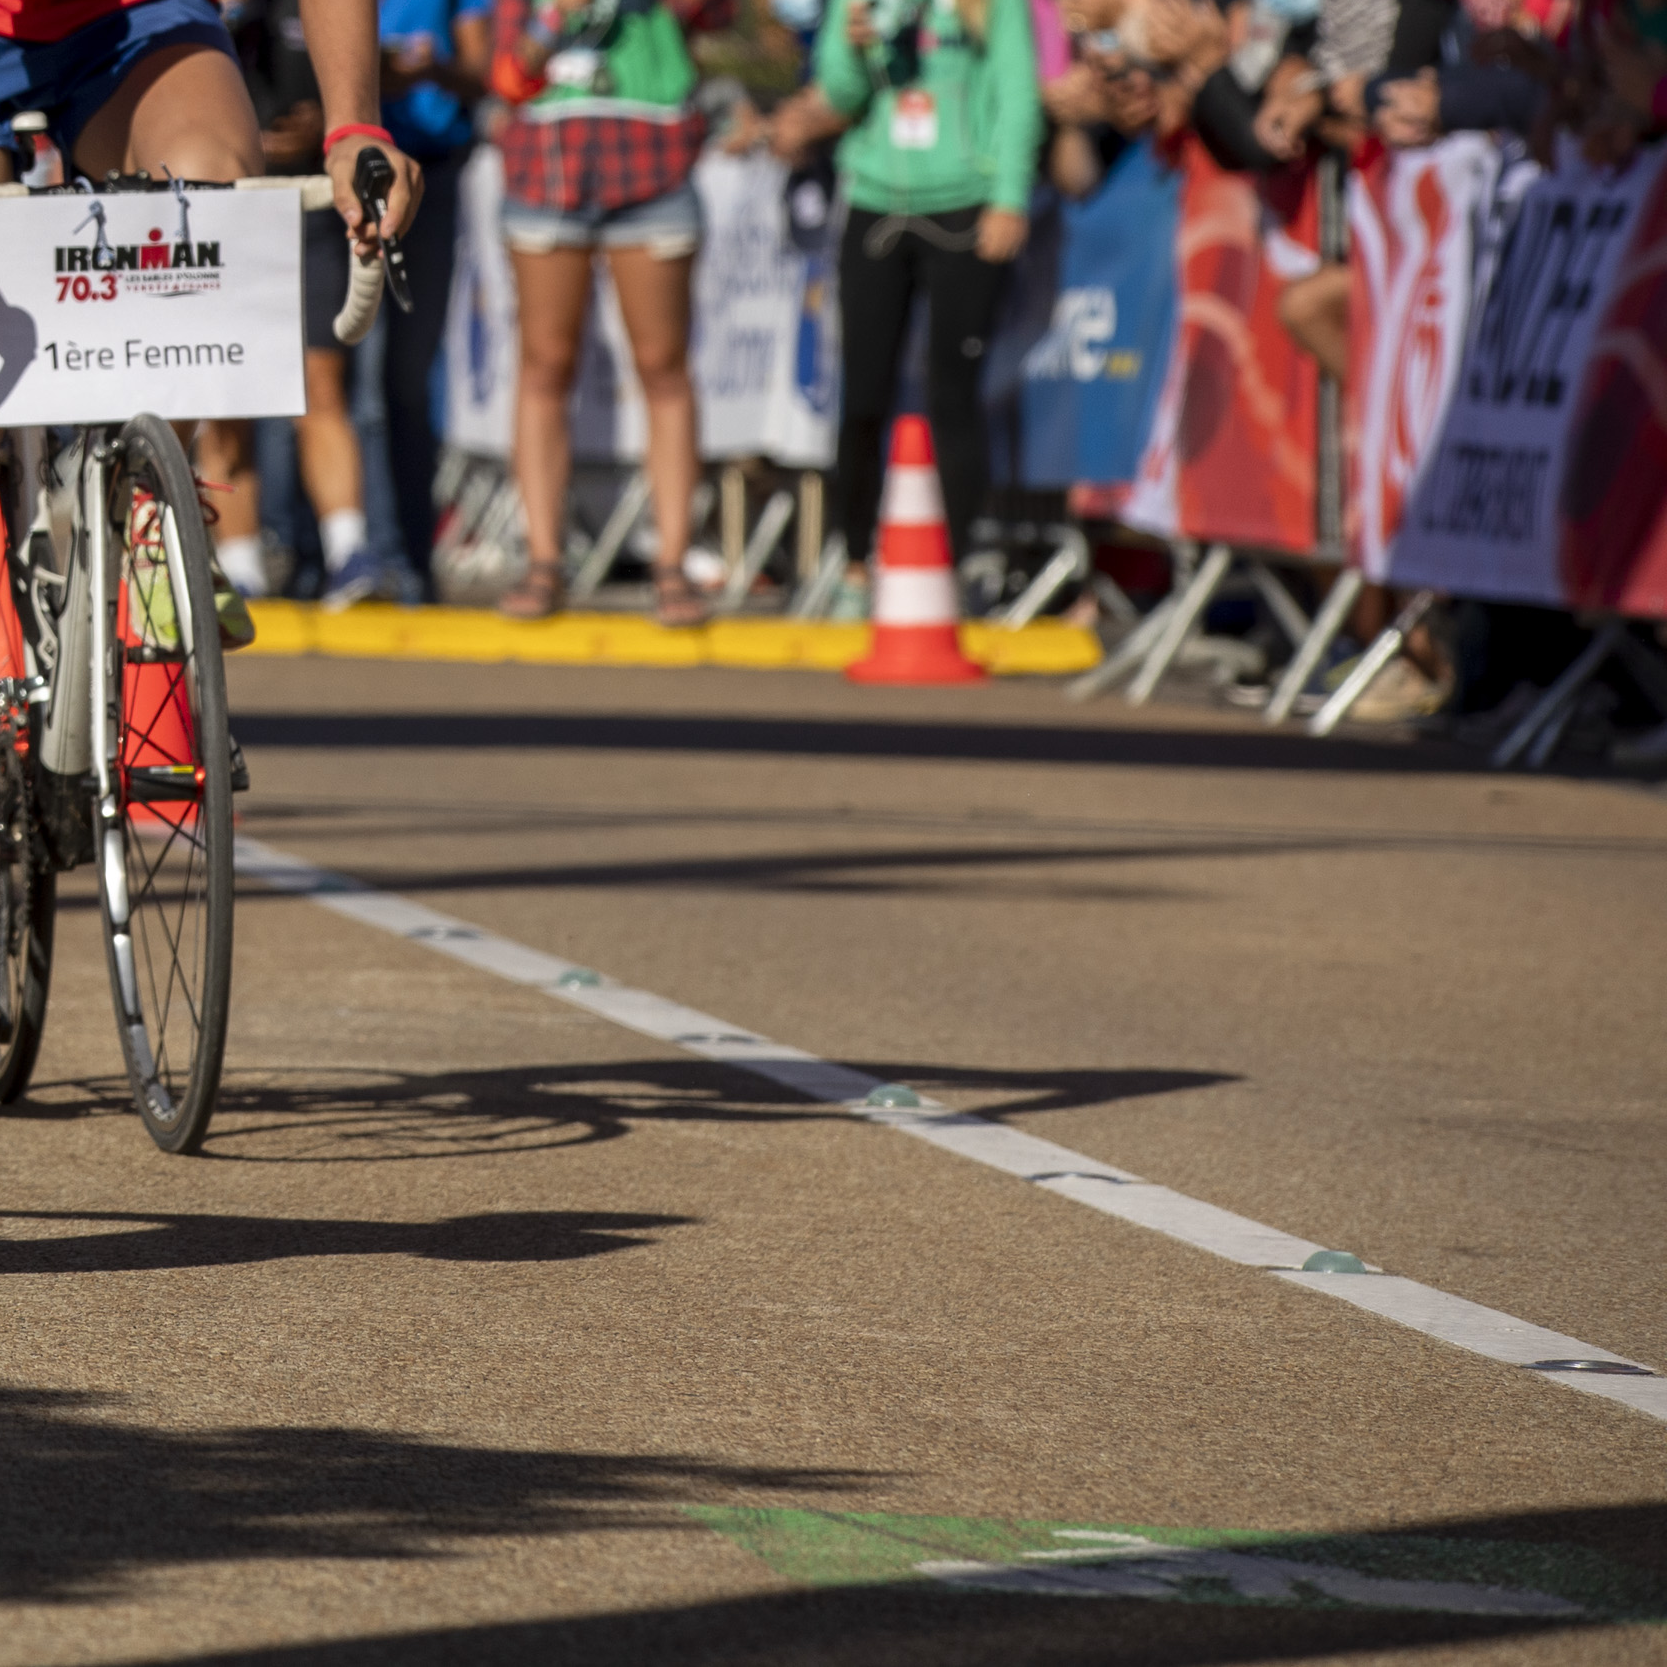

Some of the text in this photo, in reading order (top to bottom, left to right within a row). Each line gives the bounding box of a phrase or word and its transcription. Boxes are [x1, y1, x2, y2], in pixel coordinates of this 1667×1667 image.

[54, 229, 222, 272] IRONMAN
[55, 272, 118, 303] 70.3
[44, 338, 244, 371] 1ère Femme
